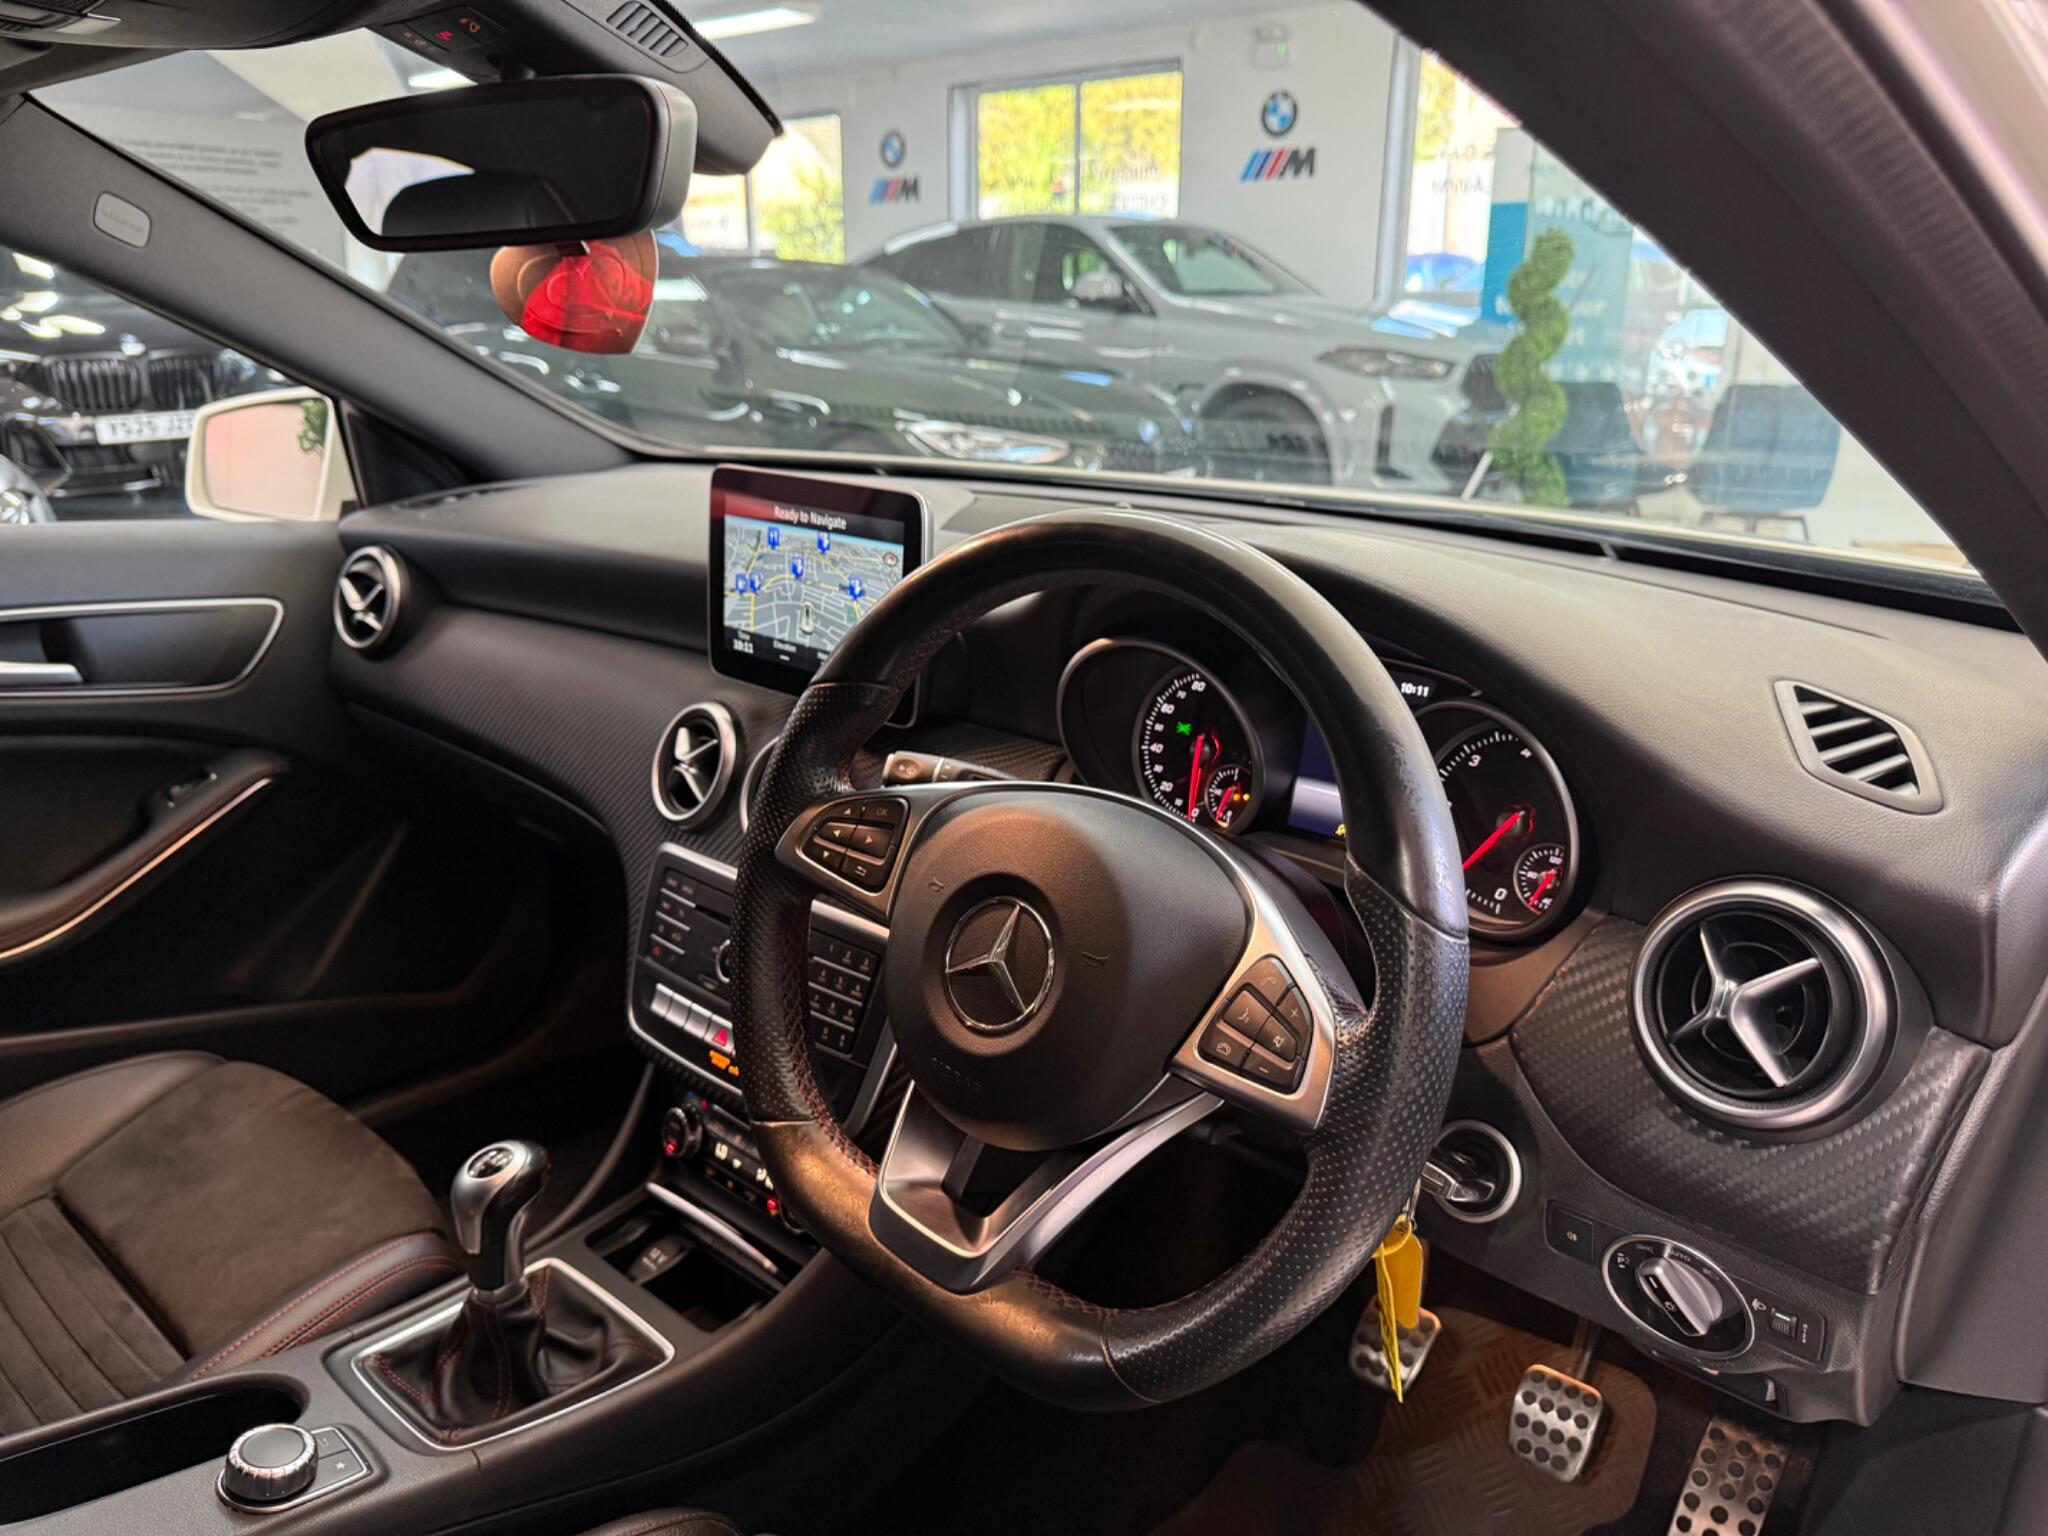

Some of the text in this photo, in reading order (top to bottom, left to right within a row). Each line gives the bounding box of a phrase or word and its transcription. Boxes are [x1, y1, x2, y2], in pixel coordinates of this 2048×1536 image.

[774, 505, 847, 530] Ready to Navigate
[1400, 682, 1430, 697] 10:11
[1149, 742, 1163, 753] 40
[1468, 754, 1481, 767] 3
[1160, 780, 1173, 792] 20
[1494, 887, 1507, 900] 0
